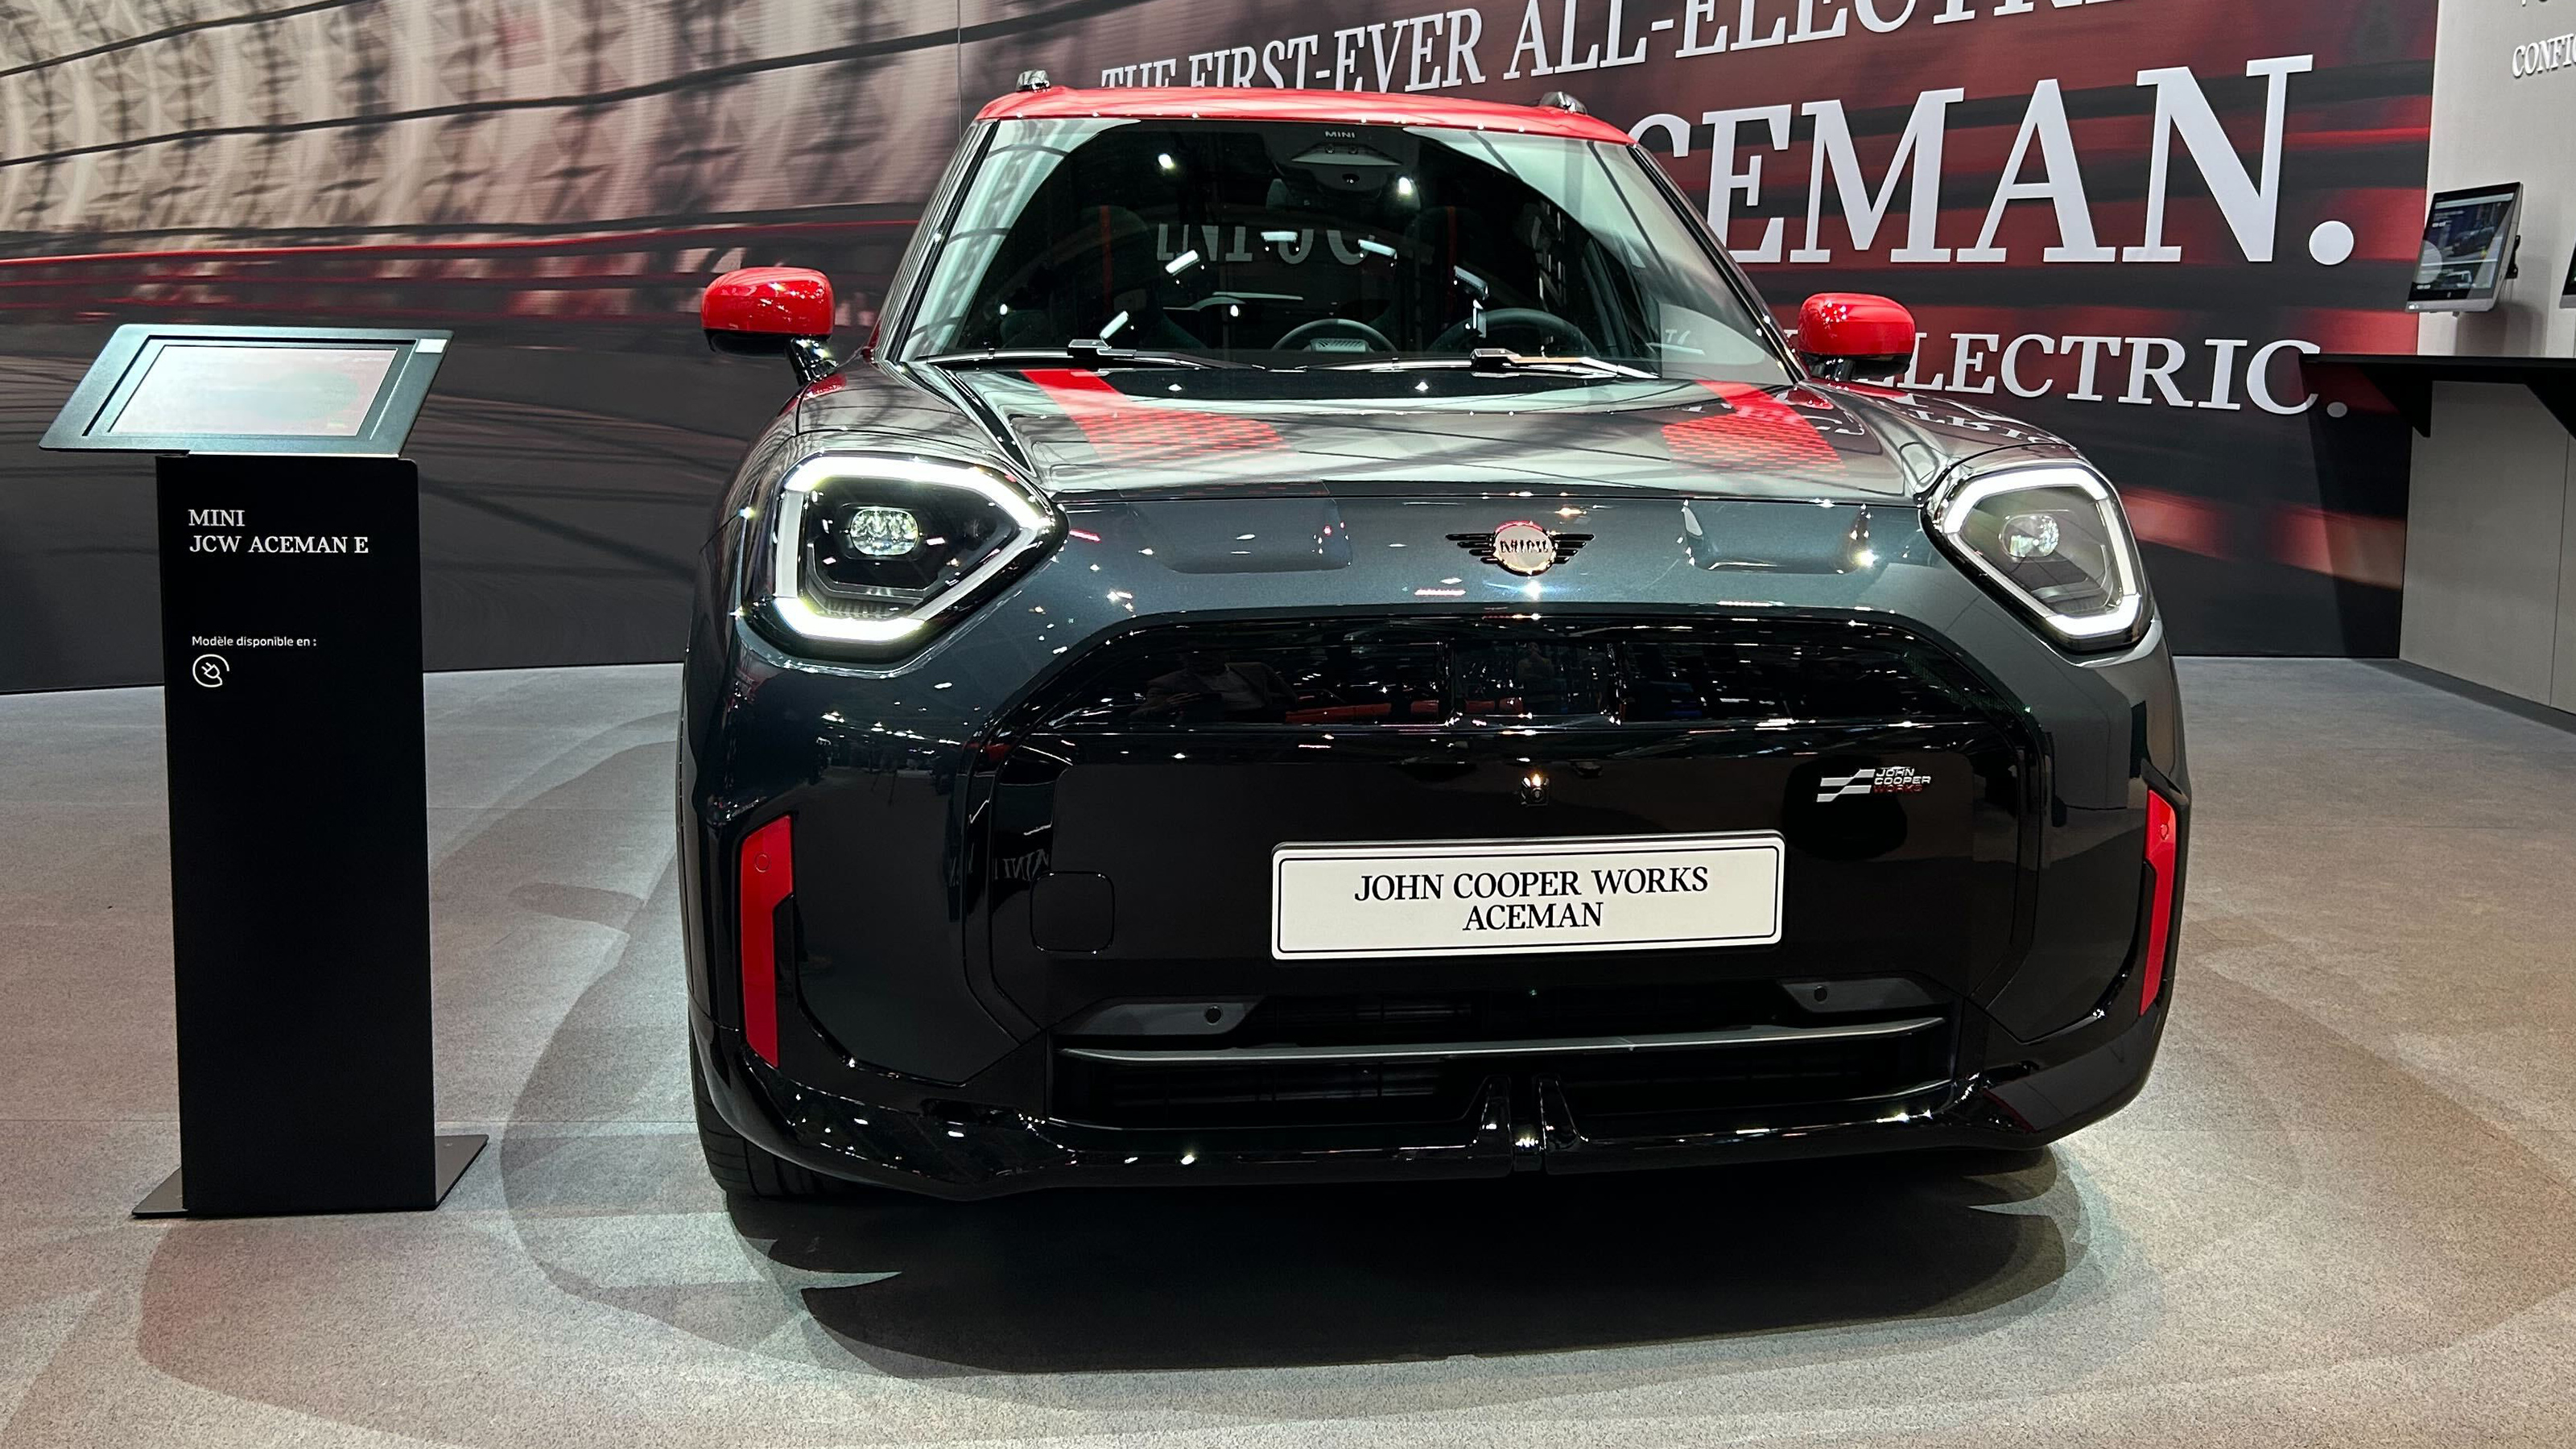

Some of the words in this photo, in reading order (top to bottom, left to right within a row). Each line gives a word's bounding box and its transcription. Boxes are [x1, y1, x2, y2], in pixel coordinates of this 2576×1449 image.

[1324, 130, 1356, 138] MINI
[1851, 332, 2348, 418] LECTRIC.
[188, 509, 246, 527] MINI
[189, 535, 242, 553] JCW
[247, 535, 349, 554] ACEMAN
[353, 536, 369, 554] E
[192, 635, 233, 647] Modèle
[236, 635, 294, 648] disponible
[296, 638, 311, 647] en
[1873, 775, 1931, 786] COOPER
[1876, 766, 1915, 778] JOHN
[1354, 873, 1444, 902] JOHN
[1453, 870, 1582, 900] COOPER
[1591, 866, 1708, 895] WORKS
[1462, 902, 1604, 931] ACEMAN
